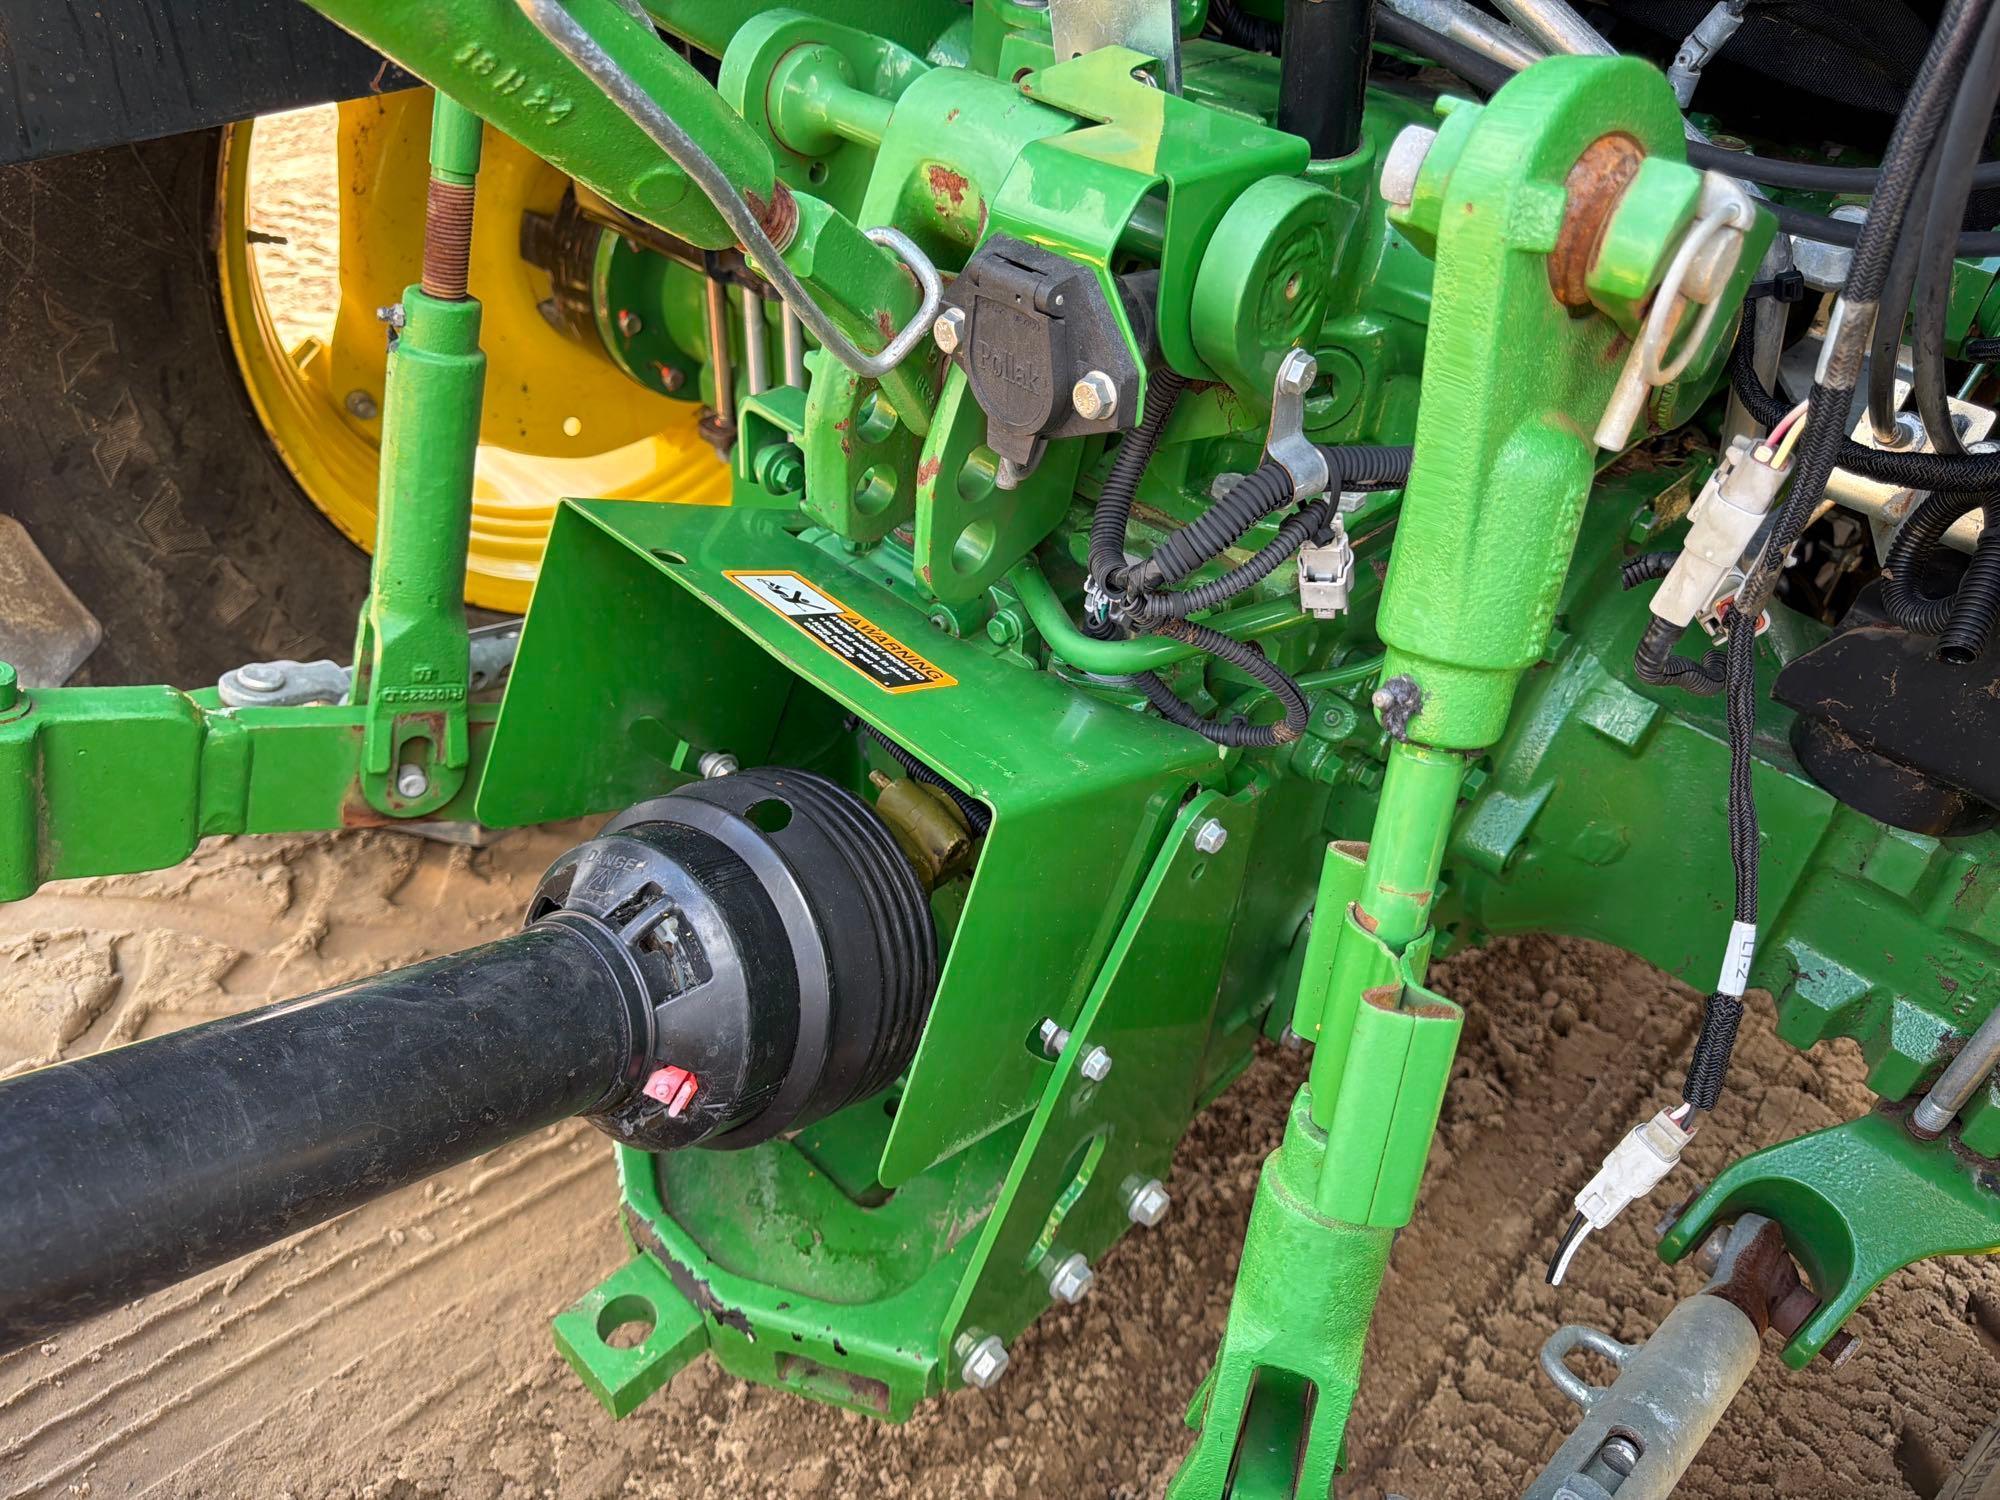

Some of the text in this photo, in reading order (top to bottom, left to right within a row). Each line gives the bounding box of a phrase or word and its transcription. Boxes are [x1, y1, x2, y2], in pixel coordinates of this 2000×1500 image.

[978, 339, 1042, 396] Pollak
[803, 622, 855, 658] clothing away
[812, 620, 832, 637] Keep
[856, 652, 874, 665] feet
[871, 663, 891, 675] and
[823, 620, 844, 636] Keep
[853, 640, 881, 661] shields
[886, 665, 911, 681] place
[829, 615, 926, 680] AVOID INJURY FROM PTO
[861, 624, 944, 680] WARNING
[585, 848, 649, 874] DANGER
